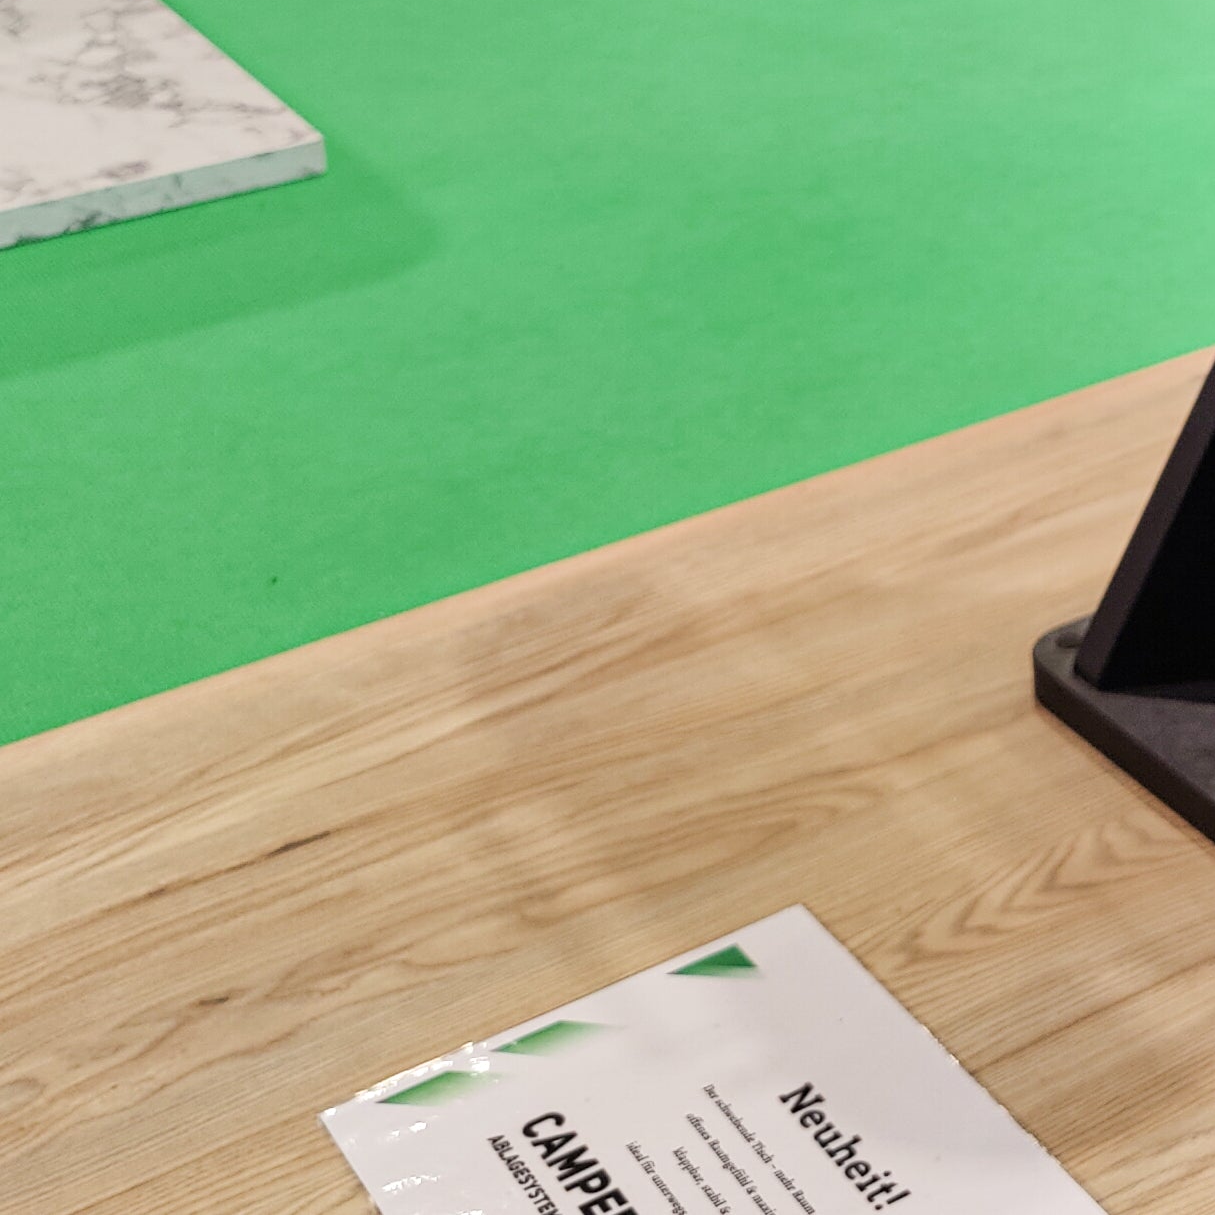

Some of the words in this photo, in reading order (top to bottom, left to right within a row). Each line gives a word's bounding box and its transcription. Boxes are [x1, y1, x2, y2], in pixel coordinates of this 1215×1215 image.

[522, 1111, 640, 1215] CAMPE
[626, 1140, 649, 1163] ideal
[641, 1160, 656, 1175] für
[672, 1146, 704, 1186] klappbar,
[701, 1185, 727, 1208] stabil
[686, 1113, 712, 1140] offenes
[708, 1138, 754, 1187] Raumgefühl
[752, 1194, 777, 1215] maxi
[703, 1084, 719, 1099] Der
[715, 1099, 756, 1142] schwebende
[752, 1139, 775, 1164] Tisch
[774, 1169, 796, 1191] mehr
[792, 1189, 816, 1215] Raum
[779, 1082, 911, 1211] Neuheit!
